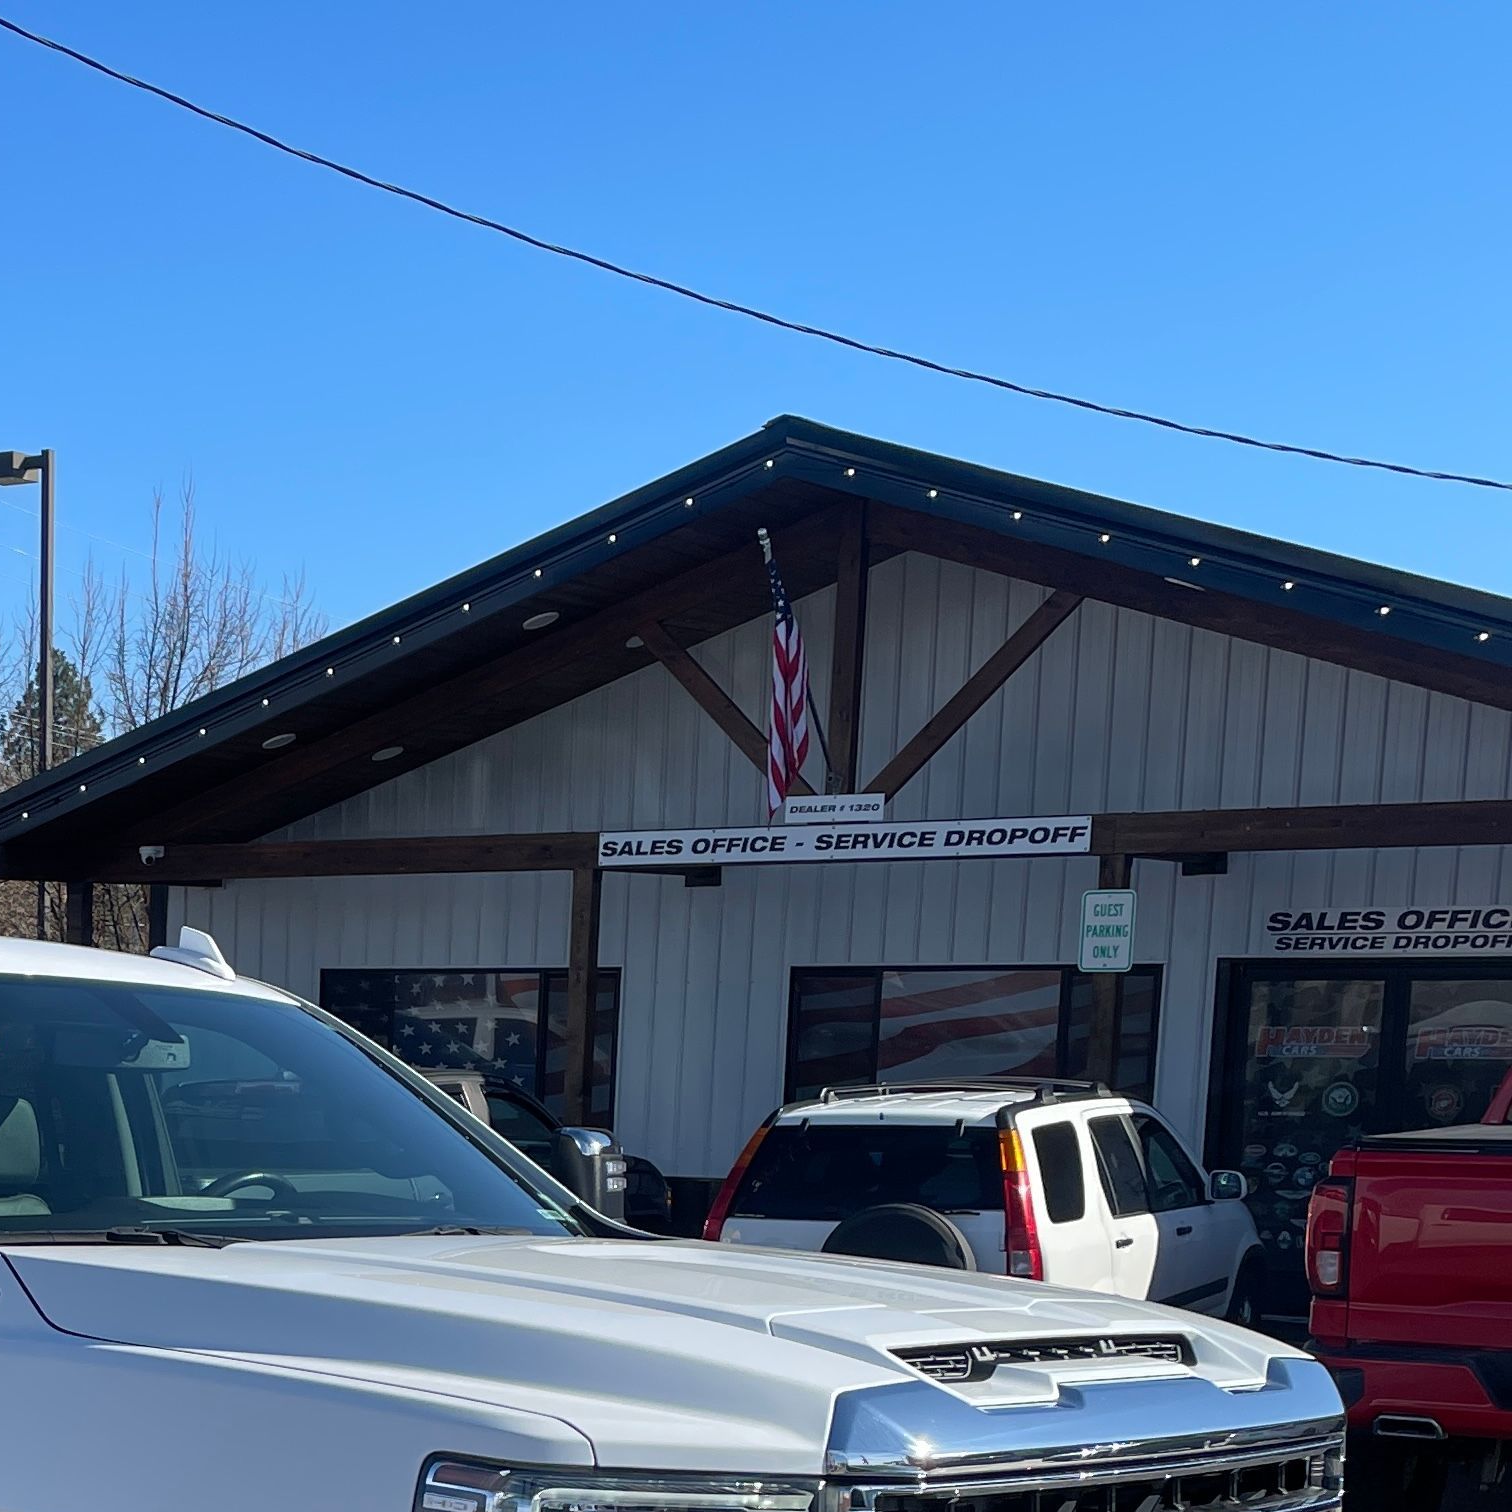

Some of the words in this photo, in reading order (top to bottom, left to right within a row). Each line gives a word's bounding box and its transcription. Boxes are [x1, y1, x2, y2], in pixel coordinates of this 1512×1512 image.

[790, 804, 837, 814] DEALER
[849, 803, 881, 812] 1320
[600, 838, 684, 857] SALES
[691, 835, 788, 855] OFFICE
[814, 830, 938, 851] SERVICE
[943, 825, 1088, 848] DROPOFF
[1093, 903, 1125, 917] GUEST
[1266, 910, 1386, 931] SALES
[1396, 908, 1512, 930] OFFIC
[1085, 924, 1129, 938] PARKING
[1274, 935, 1387, 951] SERVICE
[1092, 945, 1120, 958] ONLY
[1255, 1026, 1368, 1057] HAYDEN
[1282, 1045, 1317, 1055] CARS
[1443, 1047, 1480, 1057] CARS
